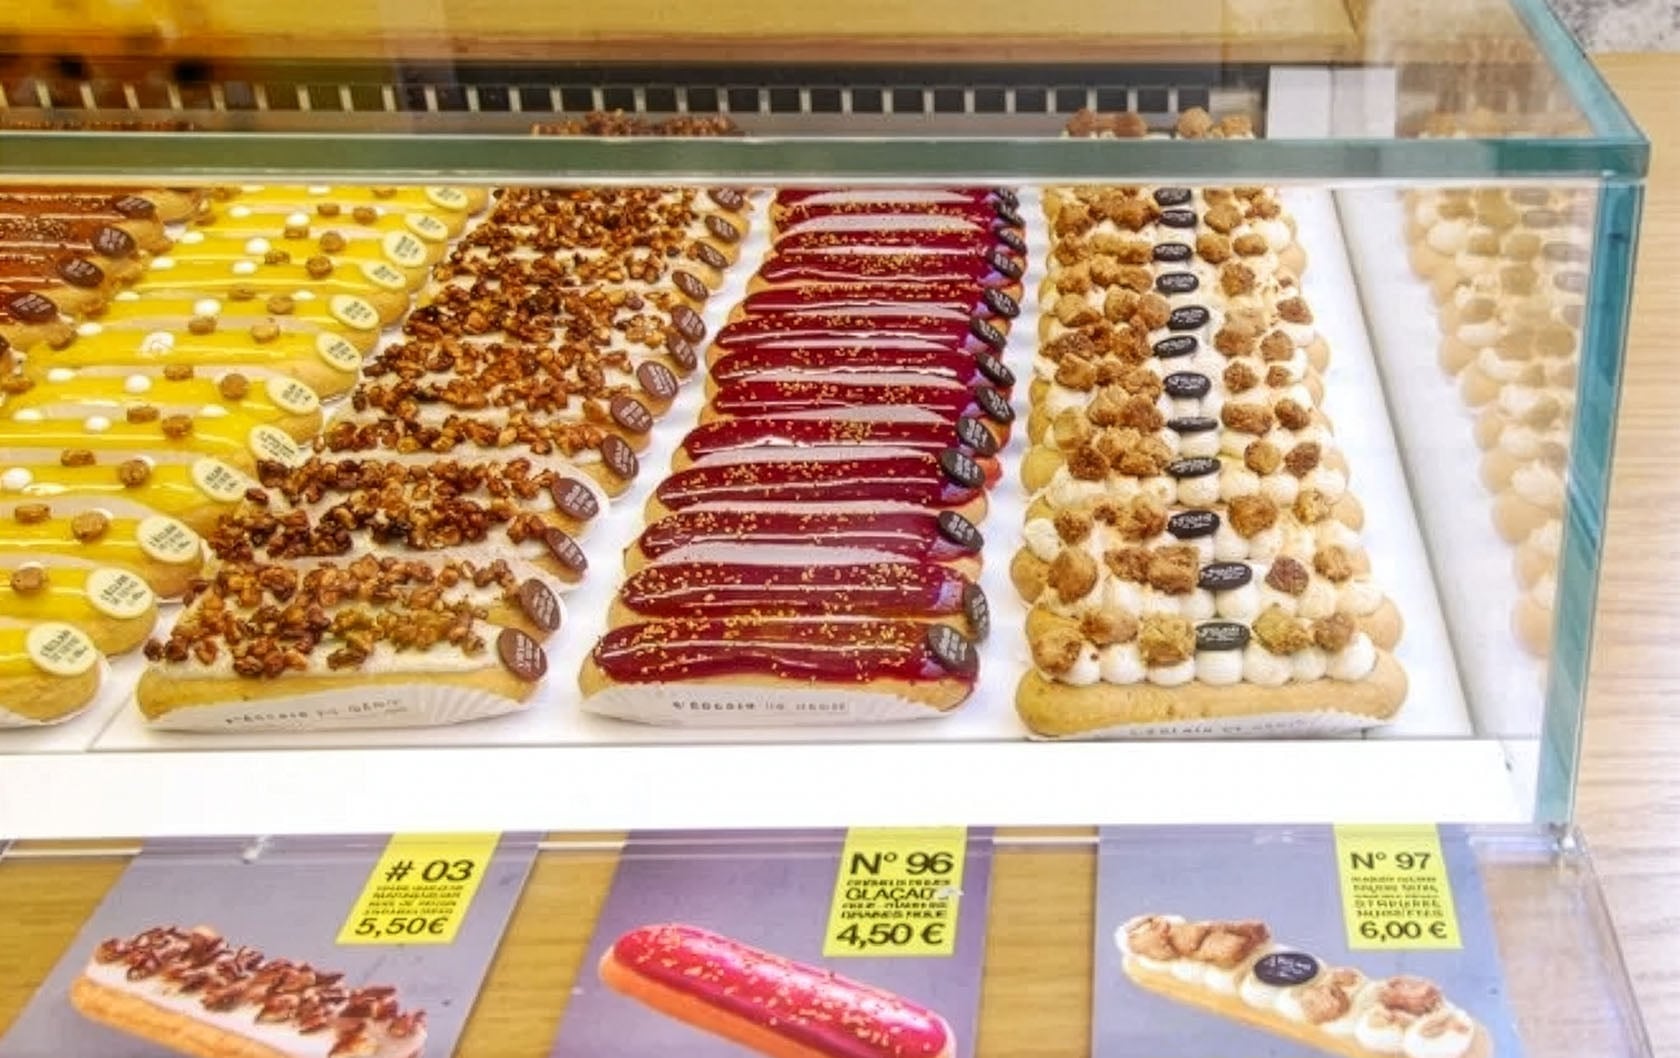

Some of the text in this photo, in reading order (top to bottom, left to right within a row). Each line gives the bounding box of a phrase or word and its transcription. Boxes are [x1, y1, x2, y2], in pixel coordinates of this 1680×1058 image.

[385, 859, 475, 883] # 03
[850, 852, 954, 875] N° 96
[1350, 851, 1431, 870] N° 97
[836, 923, 946, 948] 4,50 €
[1360, 921, 1448, 942] 6,00 €
